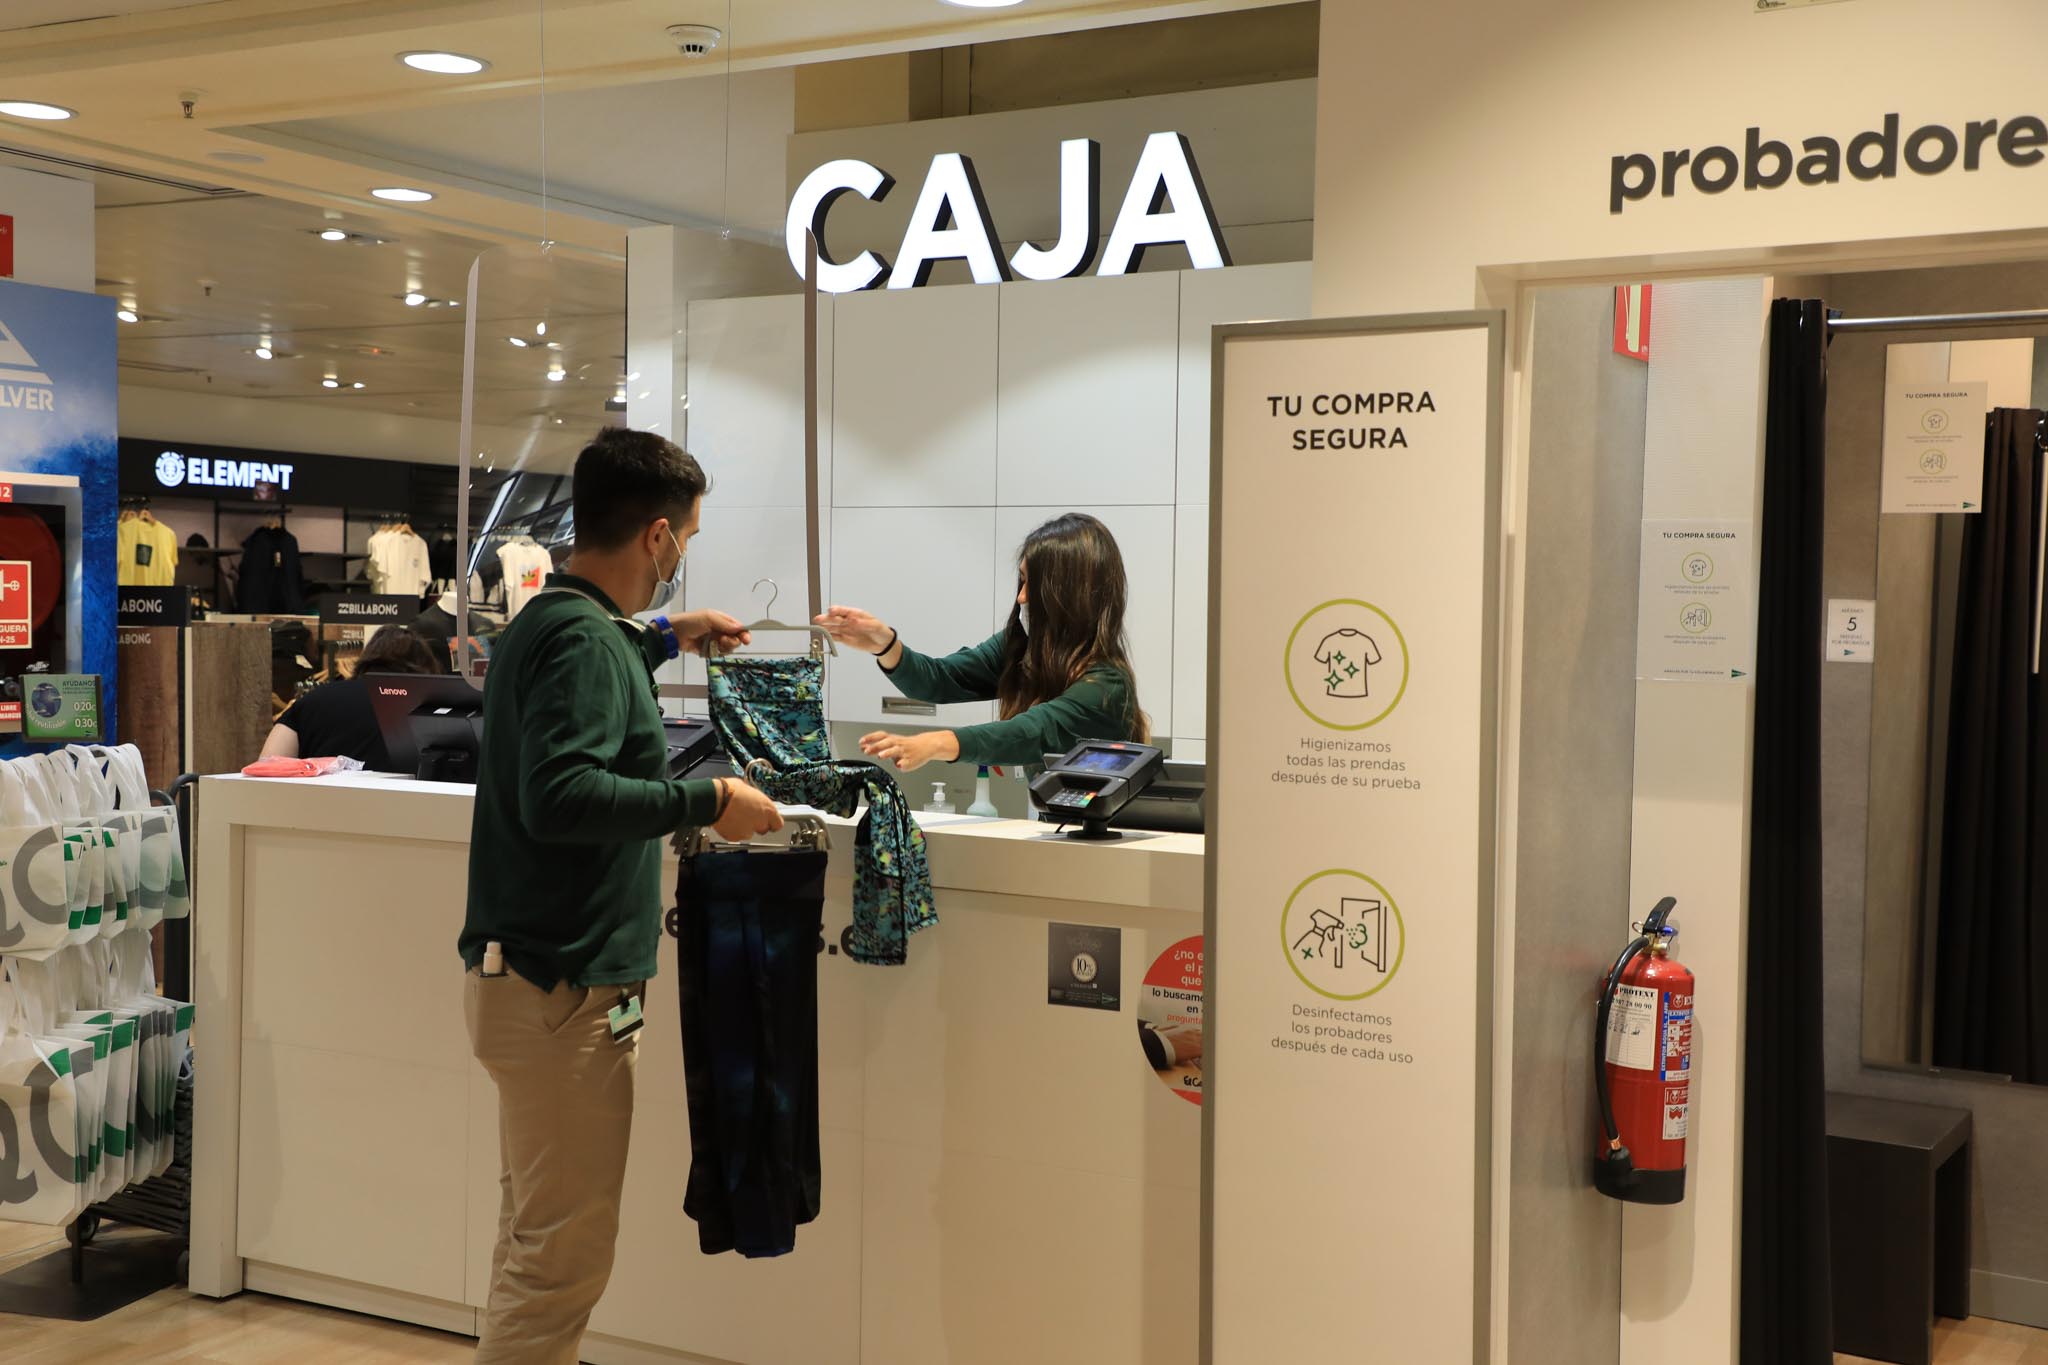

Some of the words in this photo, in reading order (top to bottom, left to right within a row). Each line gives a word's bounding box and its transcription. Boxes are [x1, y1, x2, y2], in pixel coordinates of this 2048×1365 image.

[1609, 113, 2048, 214] probadore
[786, 131, 1233, 293] CAJA
[1267, 395, 1302, 417] TU
[1312, 391, 1436, 416] COMPRA
[1292, 427, 1408, 450] SEGURA
[117, 599, 162, 613] ABONG
[349, 603, 398, 615] BILLABONG
[1847, 617, 1857, 631] 5
[117, 633, 151, 644] ABONG
[379, 686, 408, 696] Lenovo
[1300, 738, 1392, 753] Higienizamos
[1287, 754, 1324, 768] todas
[1328, 756, 1346, 768] las
[1350, 759, 1406, 771] prendas
[1271, 770, 1327, 785] después
[1331, 774, 1348, 786] de
[1352, 777, 1367, 787] su
[1372, 776, 1421, 790] prueba
[1181, 976, 1201, 987] que
[1153, 987, 1161, 997] lo
[1292, 1004, 1392, 1026] Desinfectamos
[1291, 1021, 1310, 1034] los
[1315, 1026, 1393, 1044] probadores
[1271, 1037, 1327, 1054] después
[1331, 1043, 1348, 1056] de
[1352, 1046, 1384, 1061] cada
[1389, 1053, 1413, 1064] uso
